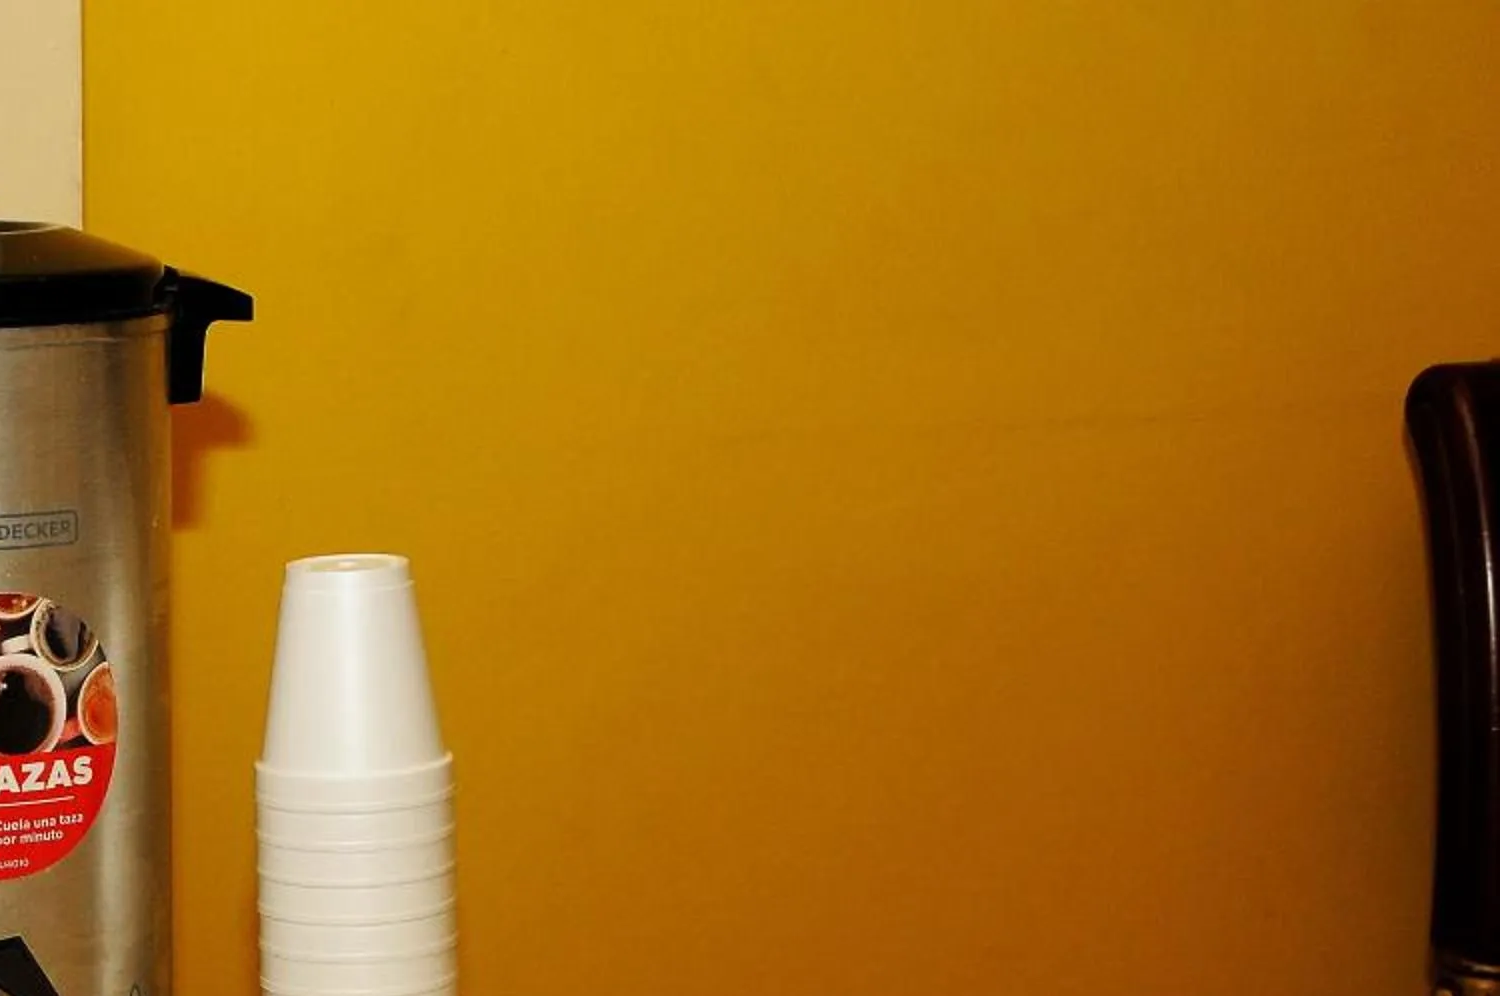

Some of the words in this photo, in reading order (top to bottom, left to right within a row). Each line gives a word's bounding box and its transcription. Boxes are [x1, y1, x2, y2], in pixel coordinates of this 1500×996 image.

[33, 817, 57, 829] una
[59, 813, 84, 825] taza
[18, 829, 64, 844] minuto
